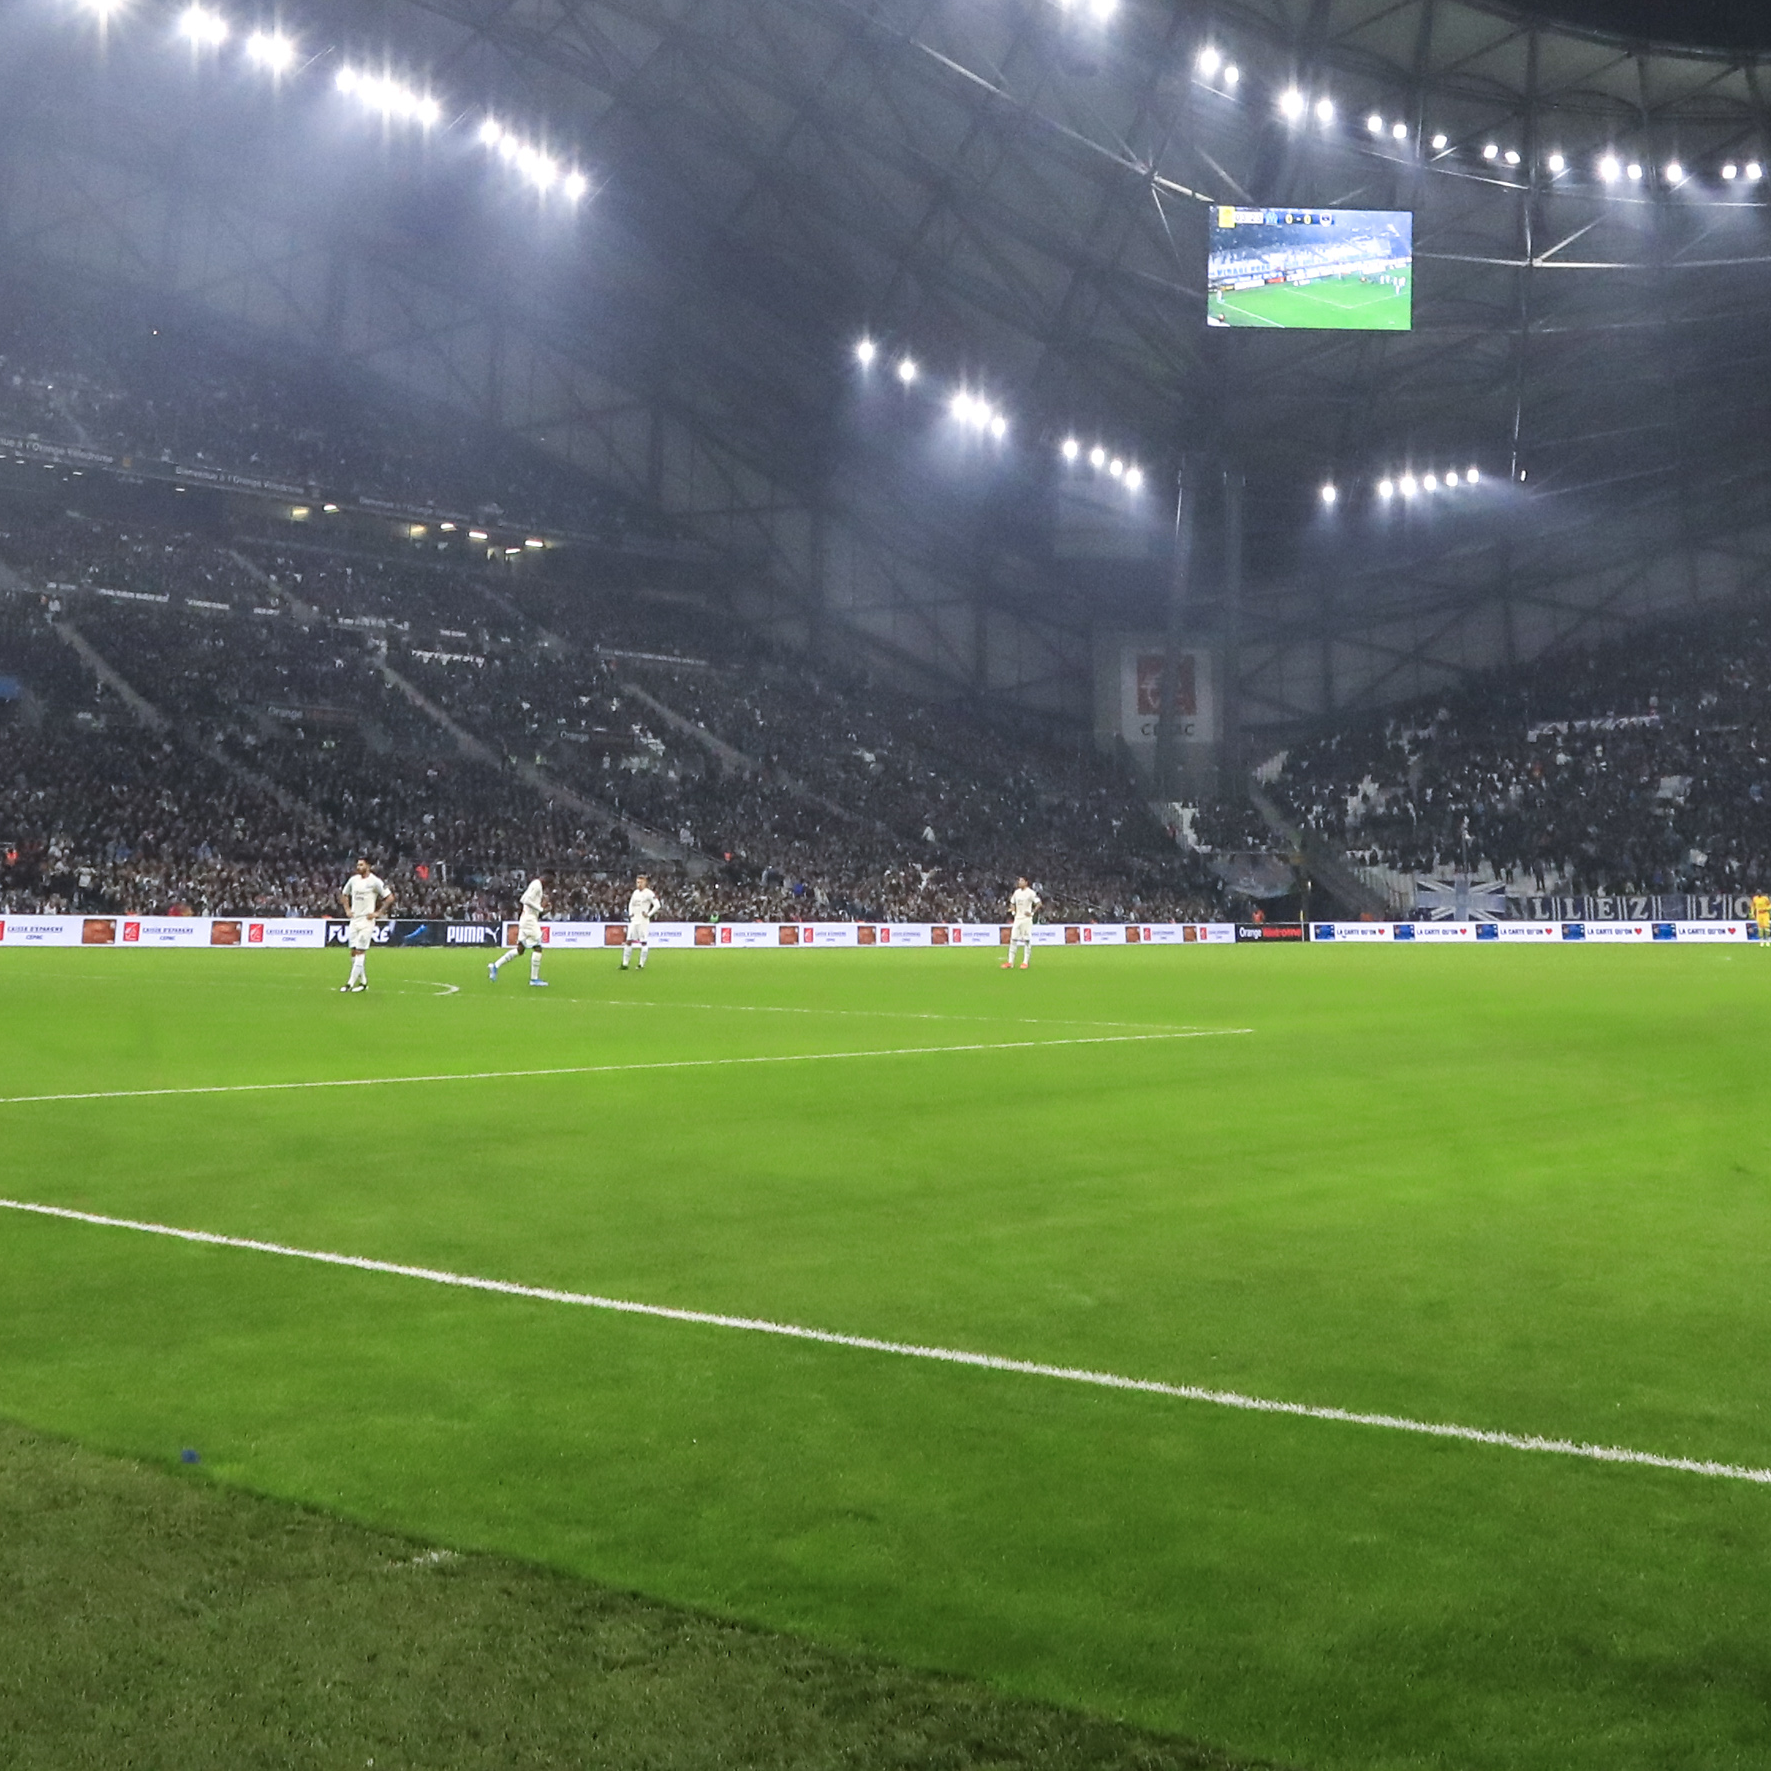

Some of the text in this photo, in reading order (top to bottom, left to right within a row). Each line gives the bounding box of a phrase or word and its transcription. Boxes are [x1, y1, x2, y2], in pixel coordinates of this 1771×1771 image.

[328, 924, 390, 943] FURE
[447, 925, 484, 943] PUMA
[1239, 926, 1262, 939] Orange
